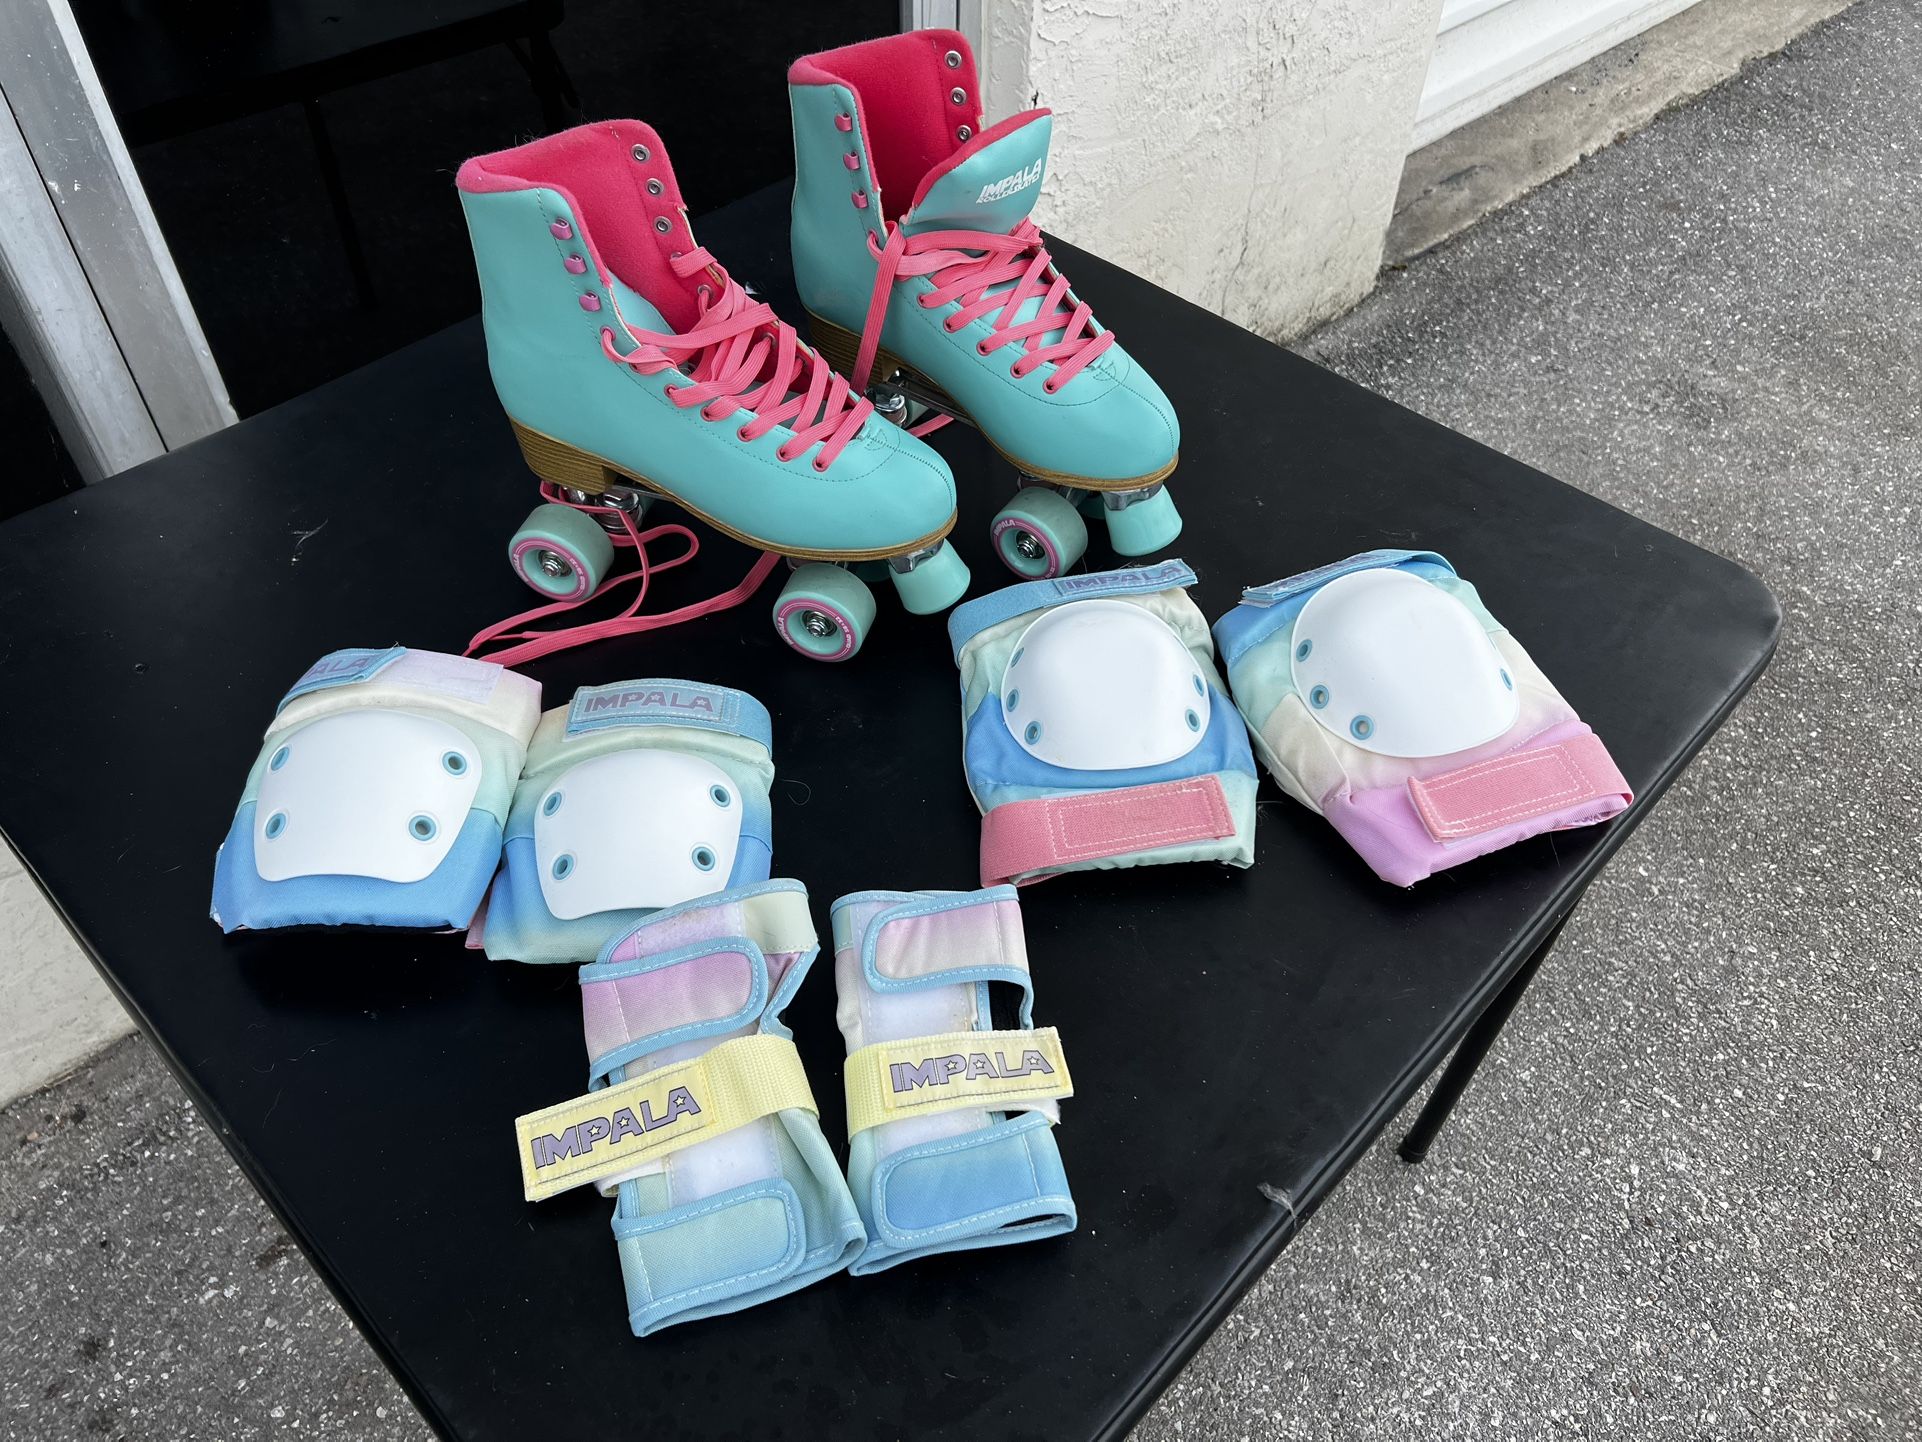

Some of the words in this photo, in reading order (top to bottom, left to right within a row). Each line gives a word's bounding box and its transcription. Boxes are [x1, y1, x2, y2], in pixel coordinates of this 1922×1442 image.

[979, 157, 1042, 199] IMPALA
[1066, 566, 1181, 589] IMPALA
[307, 656, 371, 678] ALA
[584, 691, 713, 713] IMPALA
[889, 1049, 1055, 1093] IMPALA
[530, 1086, 702, 1169] IMPALA
